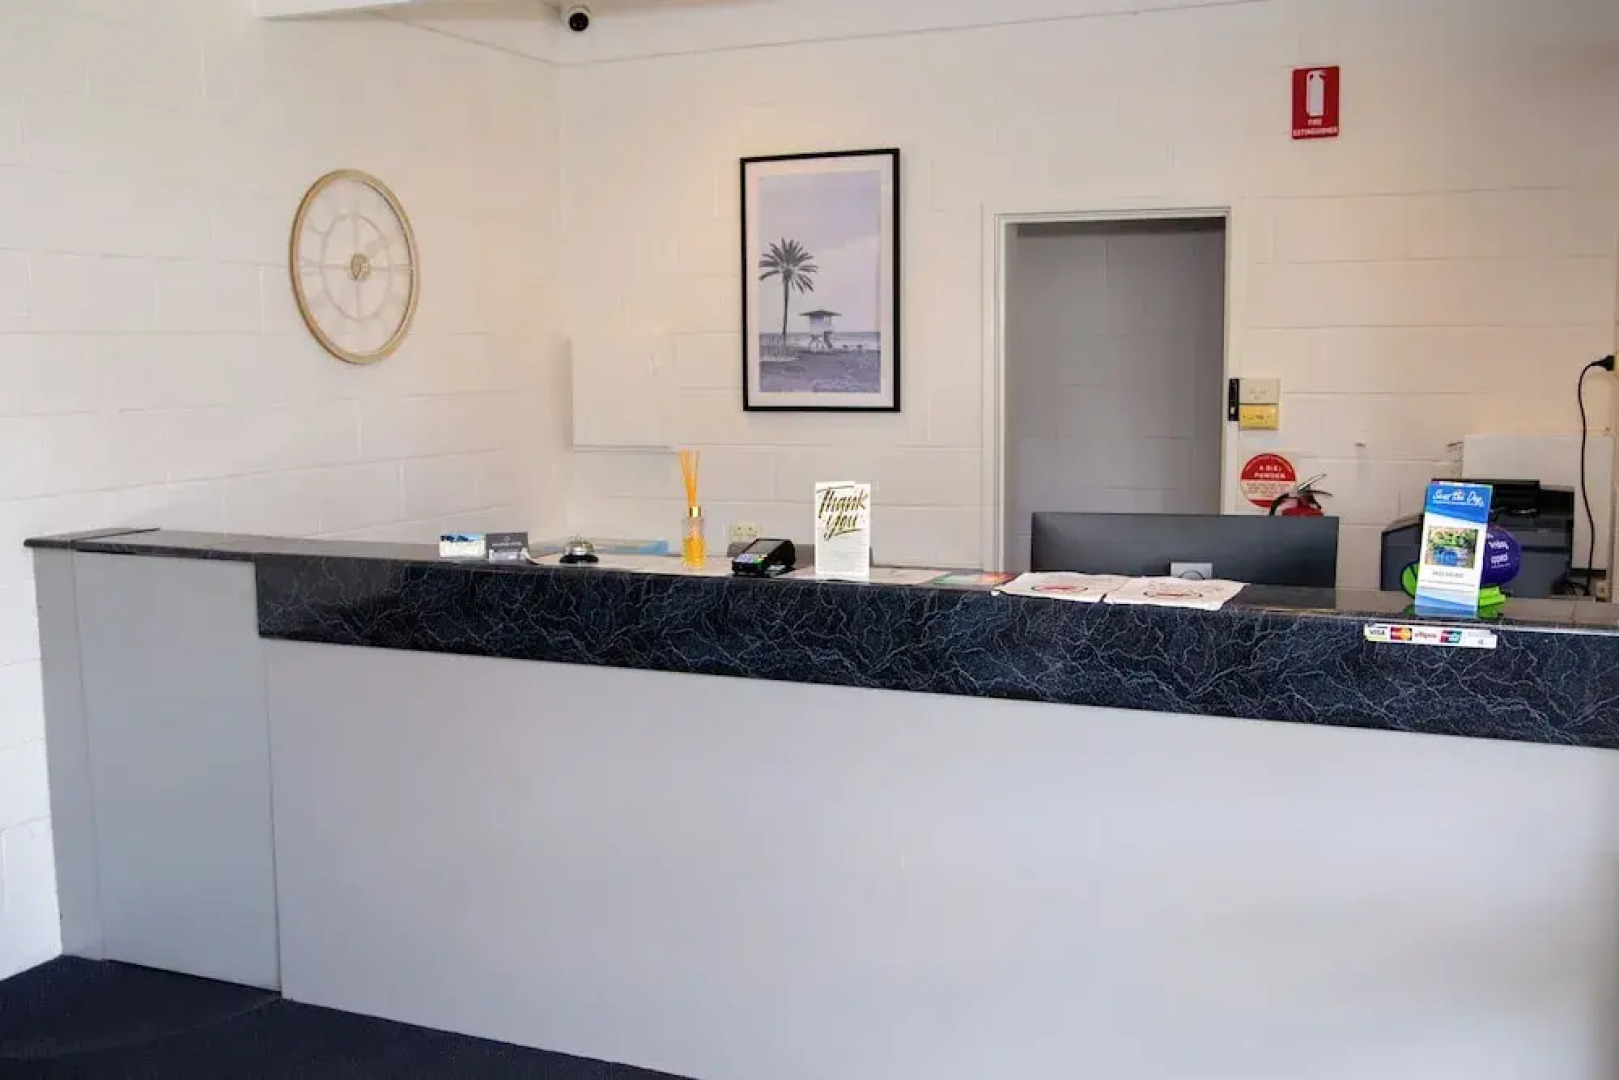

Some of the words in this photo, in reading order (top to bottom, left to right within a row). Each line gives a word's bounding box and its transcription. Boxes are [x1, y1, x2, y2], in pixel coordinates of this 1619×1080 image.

[1307, 118, 1322, 126] FIRE
[1293, 127, 1338, 137] EXTINGUISHER
[816, 485, 868, 518] Thank
